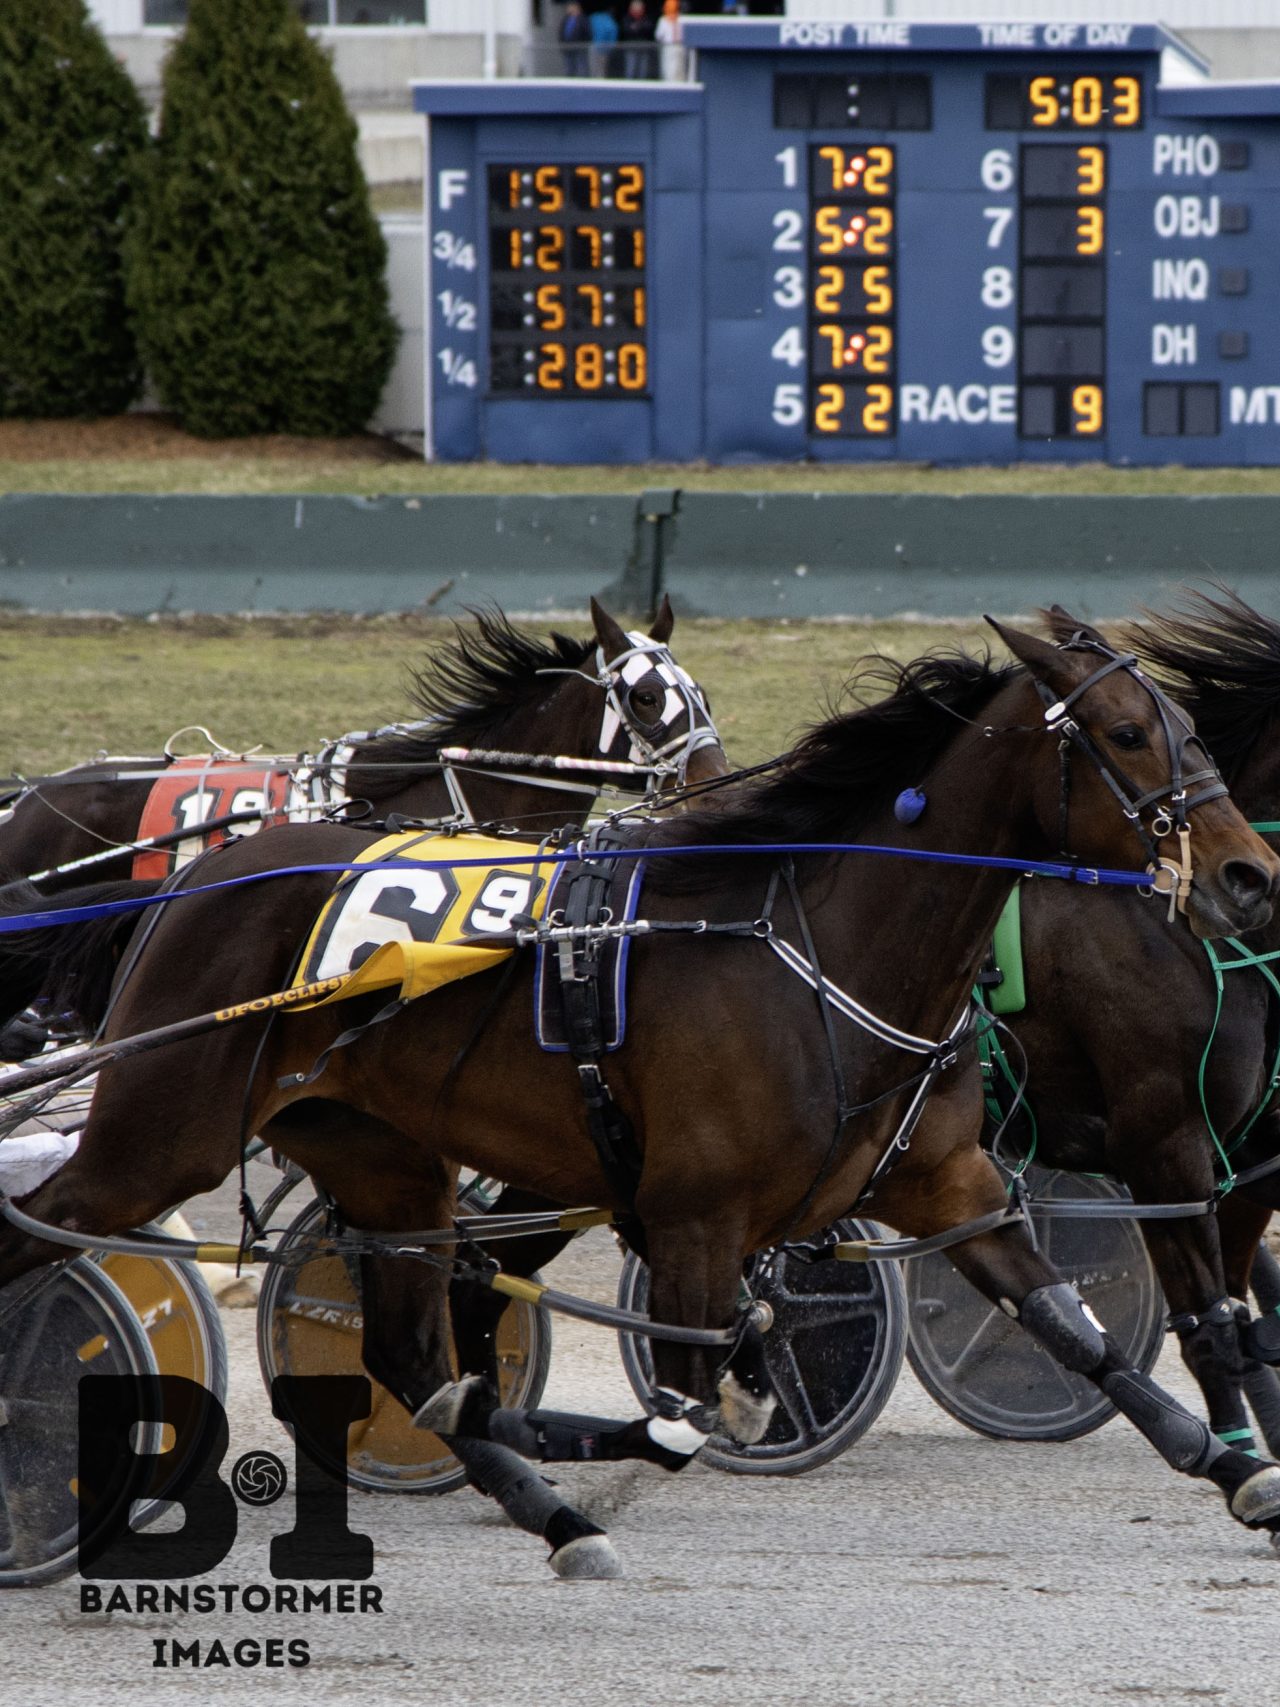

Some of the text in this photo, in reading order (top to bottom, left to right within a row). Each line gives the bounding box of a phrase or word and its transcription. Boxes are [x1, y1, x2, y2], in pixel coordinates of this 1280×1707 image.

[780, 24, 910, 46] POST TIME
[977, 24, 1132, 46] TIME OF DAY
[1029, 77, 1140, 125] 5:03
[775, 146, 796, 187] 1
[981, 149, 1013, 191] 6
[1076, 146, 1104, 195] 3
[1153, 134, 1219, 176] PHO
[438, 169, 468, 210] F
[509, 165, 644, 213] 1:57:2
[772, 209, 802, 250] 2
[982, 207, 1013, 248] 7
[1076, 206, 1104, 254] 3
[1153, 195, 1220, 237] OBJ
[510, 225, 644, 272] 1:27:1
[773, 265, 804, 308] 3
[981, 265, 1014, 308] 8
[1153, 258, 1209, 301] INQ
[771, 326, 805, 367] 4
[981, 326, 1014, 368] 9
[1152, 324, 1197, 365] DH
[771, 384, 804, 425] 5
[900, 384, 1017, 422] RACE
[1072, 384, 1102, 433] 9
[315, 868, 532, 982] 6 9
